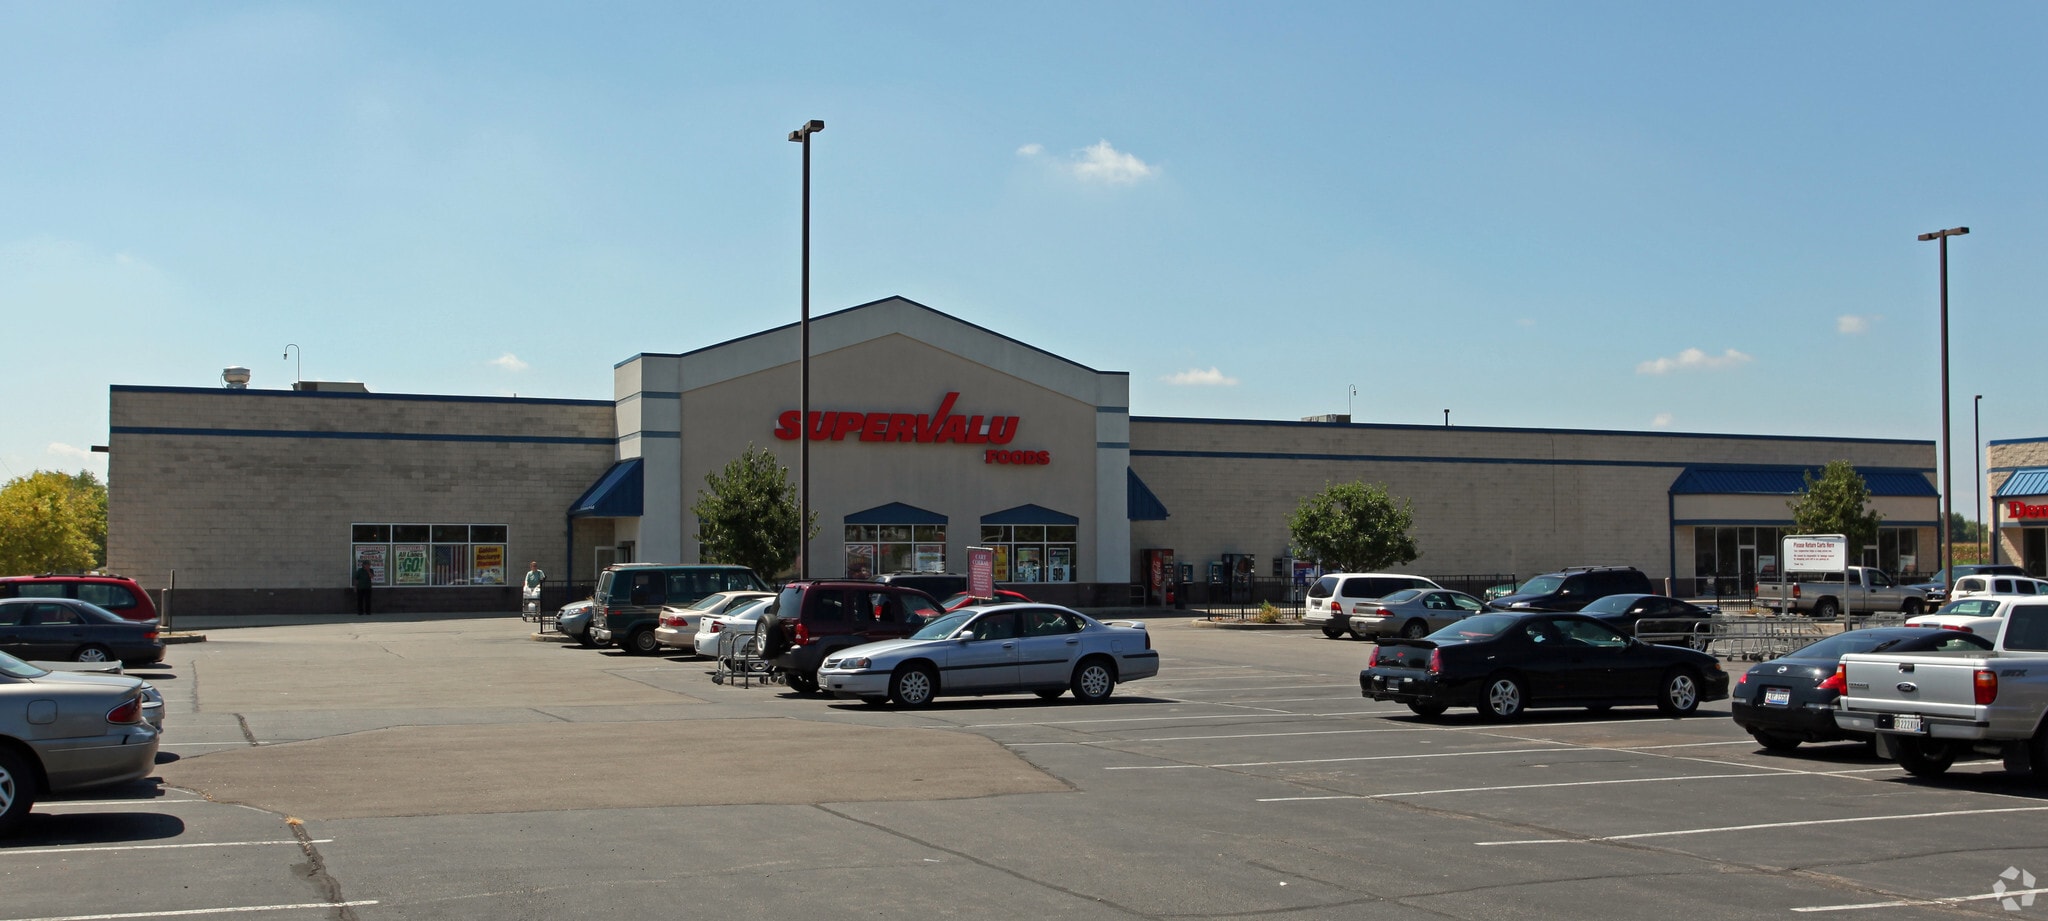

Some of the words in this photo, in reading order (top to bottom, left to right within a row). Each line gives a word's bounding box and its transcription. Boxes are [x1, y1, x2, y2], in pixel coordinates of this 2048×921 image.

[774, 392, 1020, 445] SUPERVALU
[985, 449, 1051, 465] FOODS
[404, 557, 424, 573] GO!
